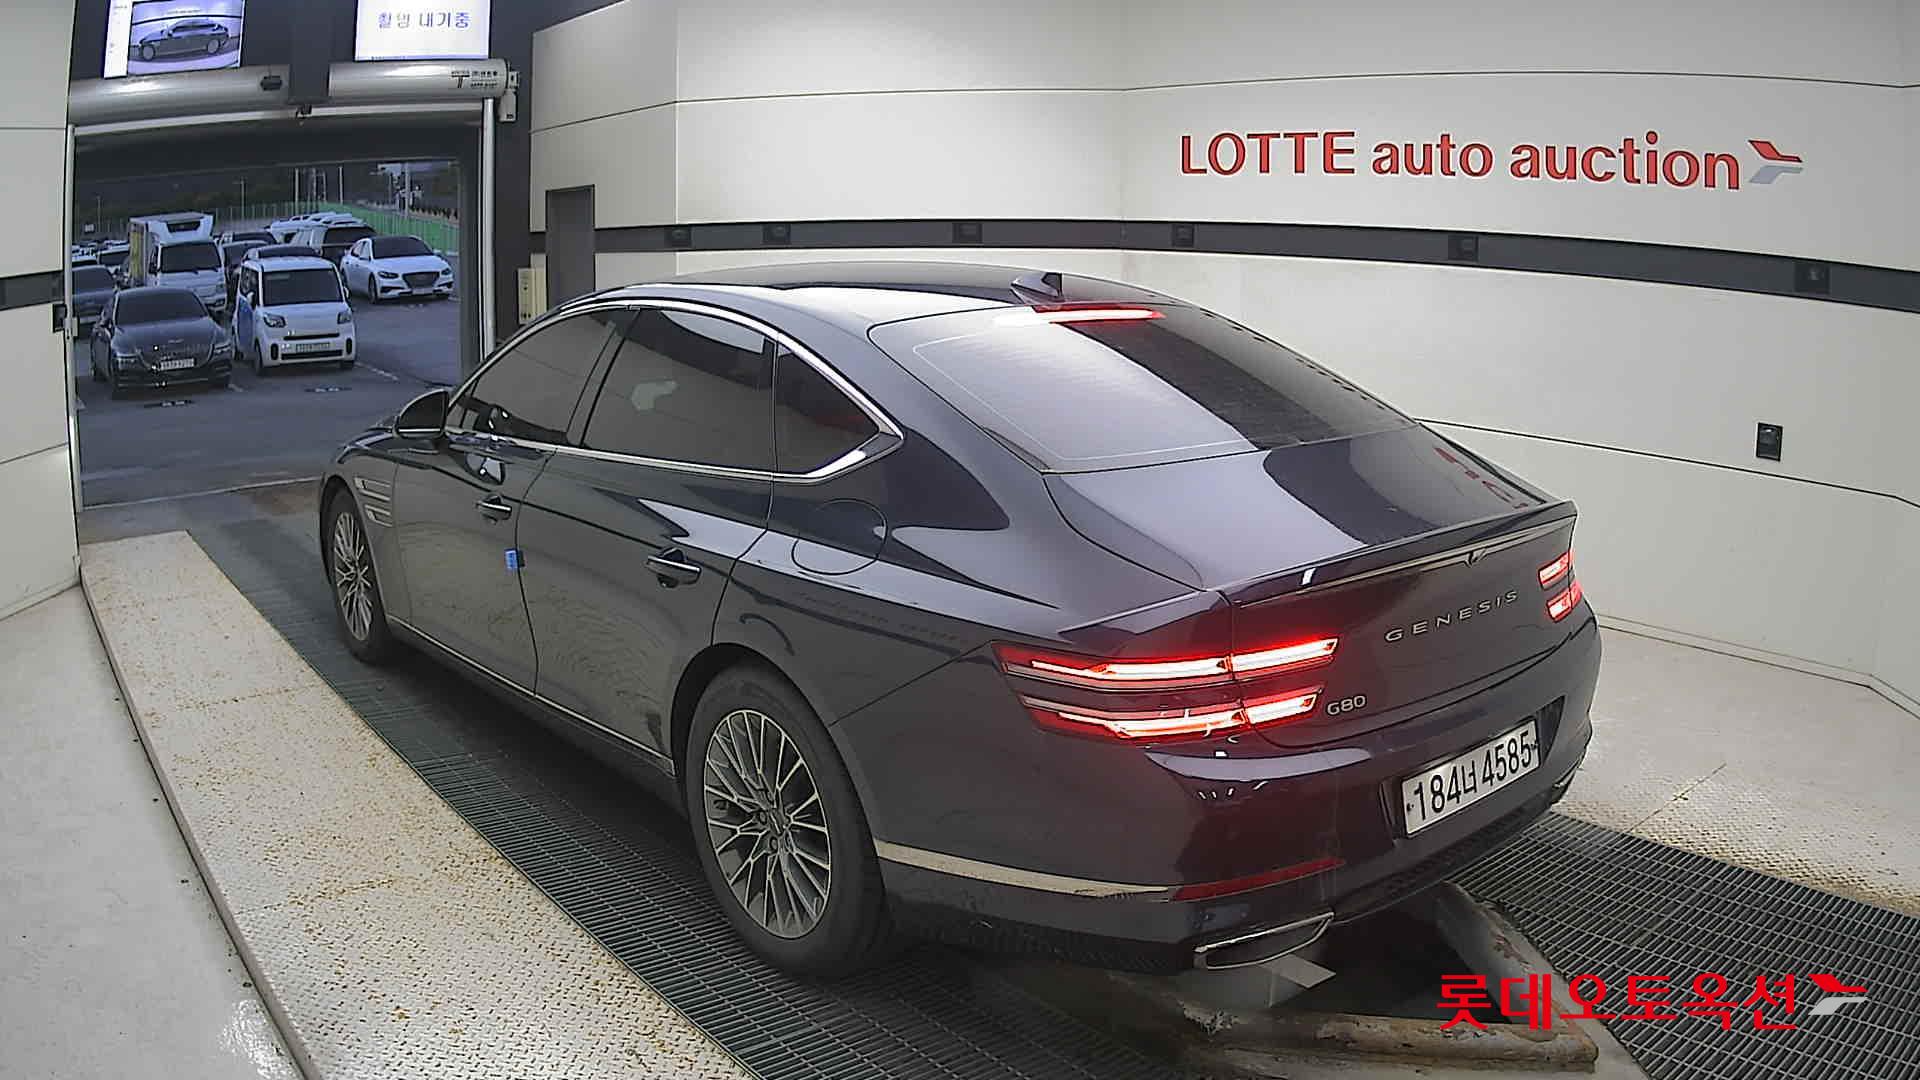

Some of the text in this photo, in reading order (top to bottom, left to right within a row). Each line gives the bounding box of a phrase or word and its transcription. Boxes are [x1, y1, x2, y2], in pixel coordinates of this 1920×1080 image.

[1180, 130, 1741, 190] LOTTE auto auction
[1384, 590, 1518, 643] GENESIS
[1326, 695, 1367, 716] G80
[1413, 729, 1532, 821] 184너 4585
